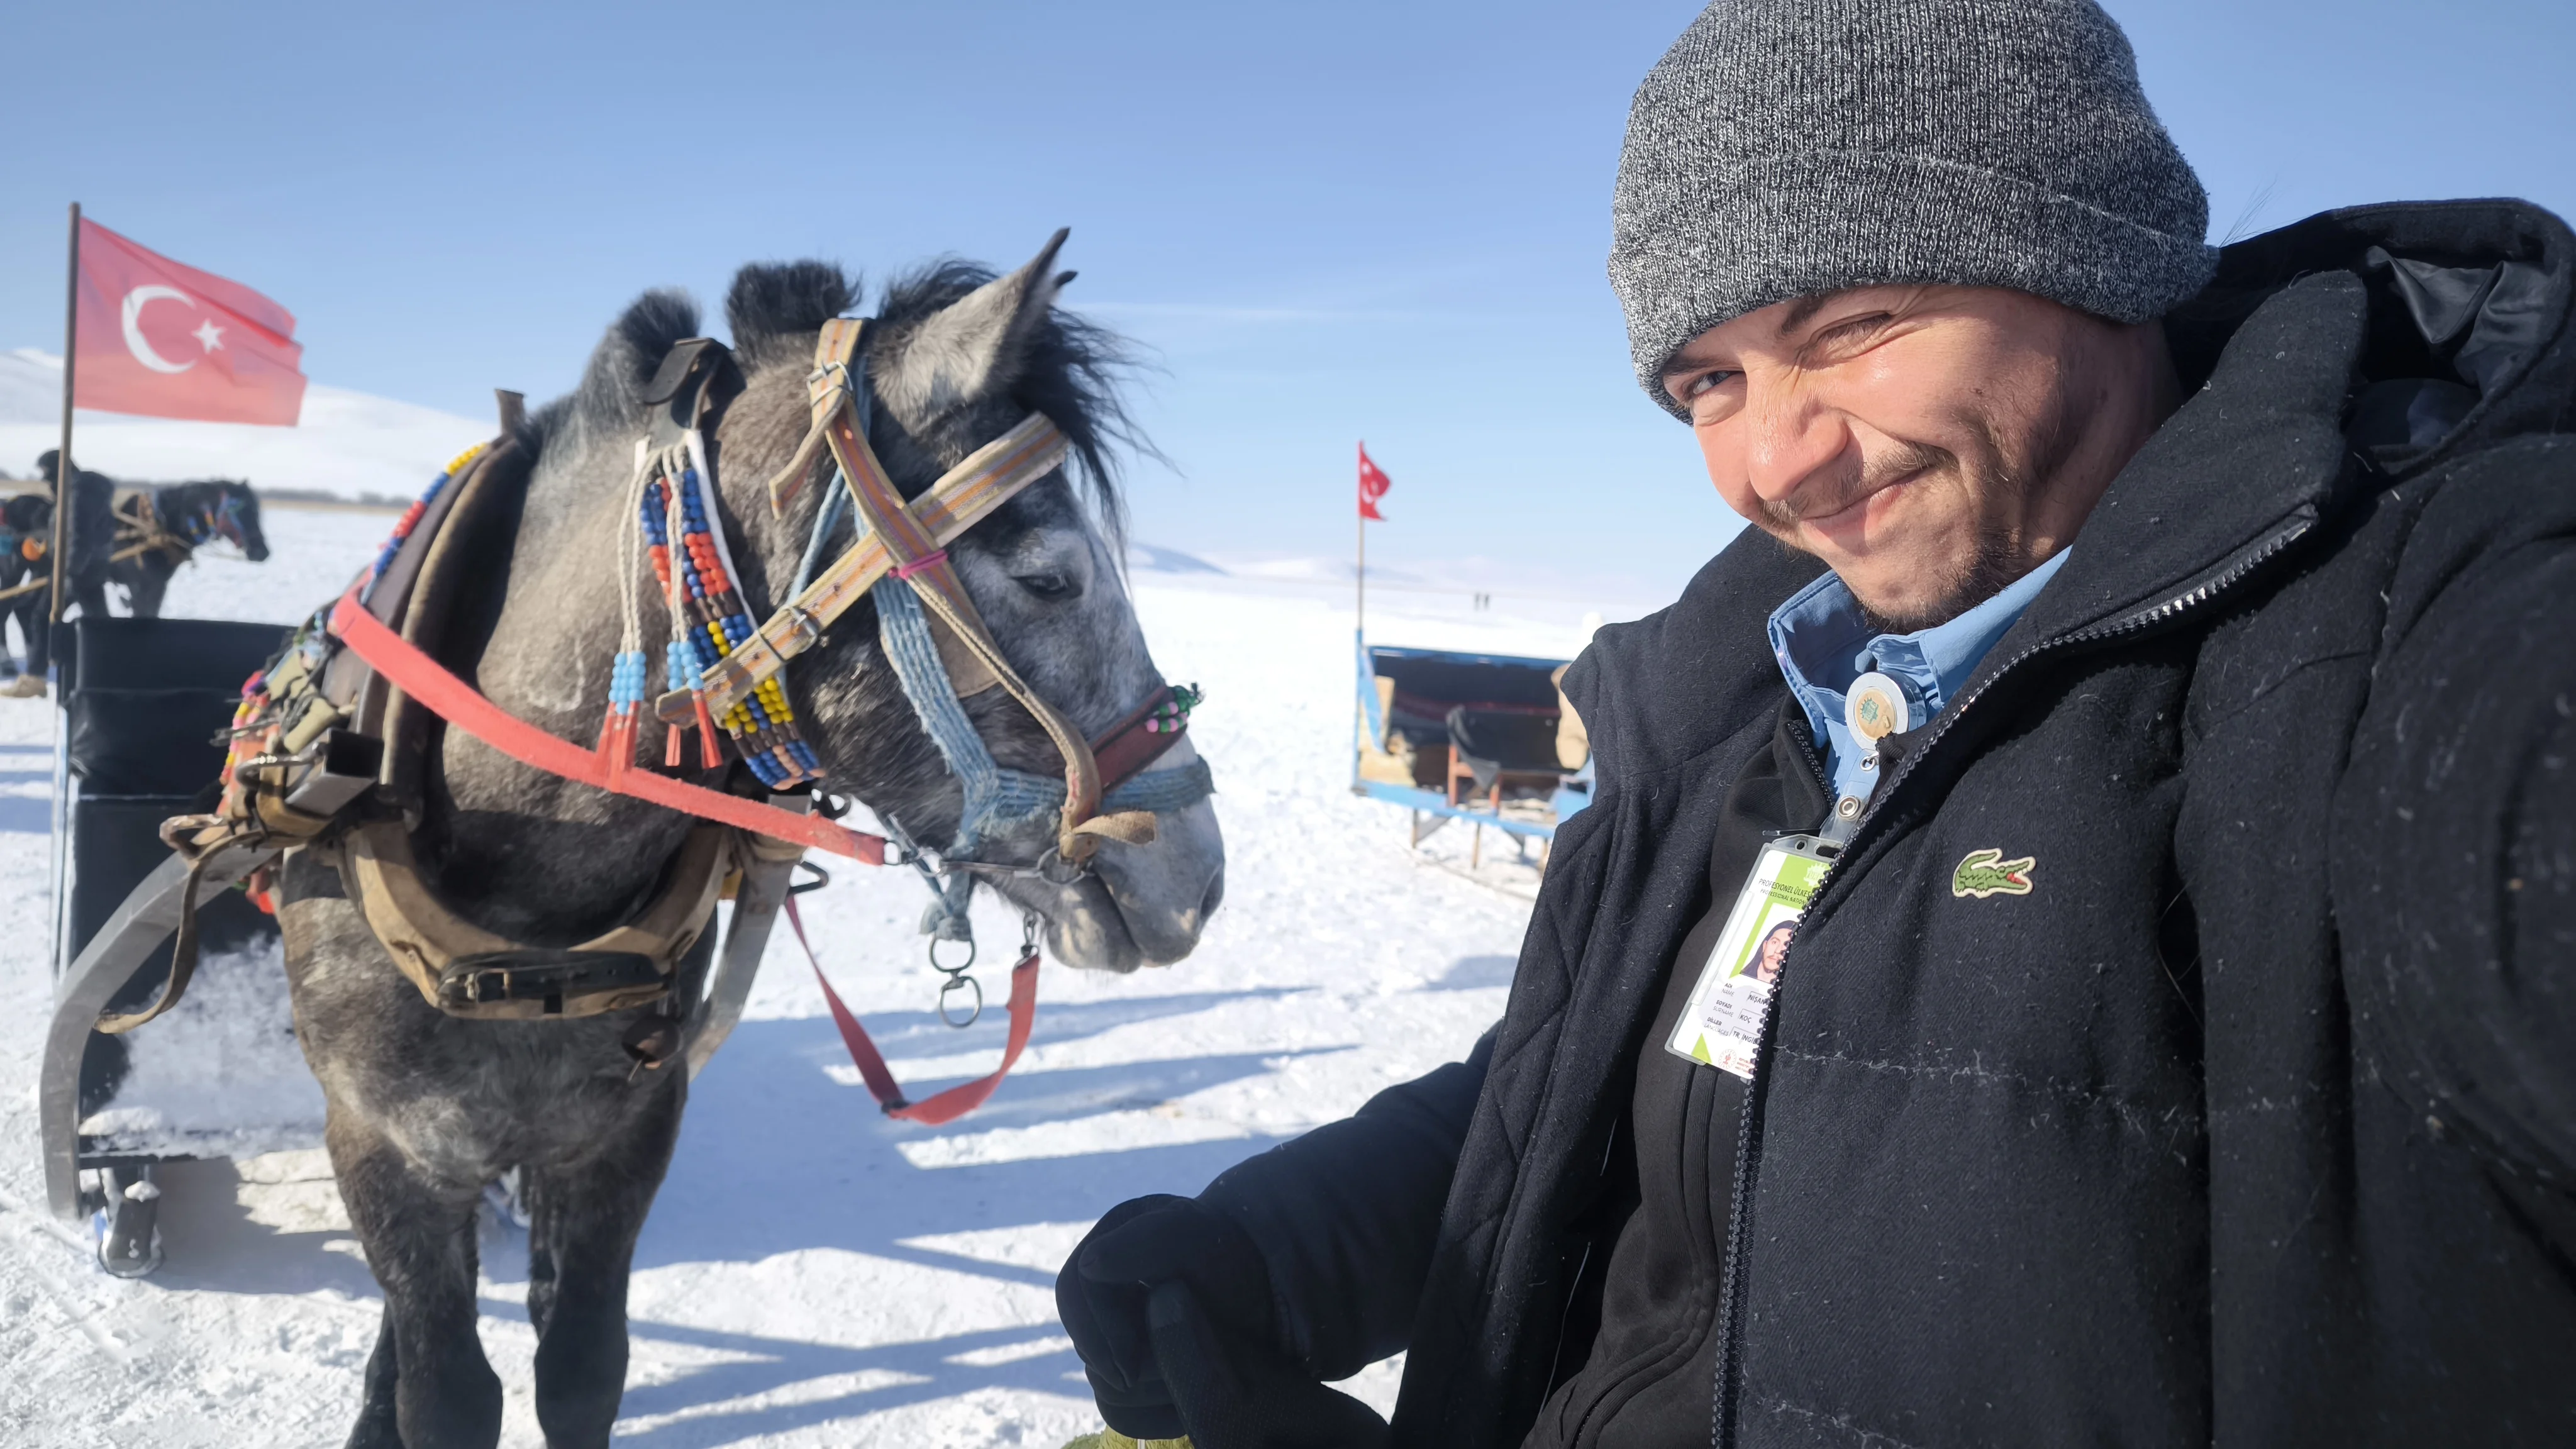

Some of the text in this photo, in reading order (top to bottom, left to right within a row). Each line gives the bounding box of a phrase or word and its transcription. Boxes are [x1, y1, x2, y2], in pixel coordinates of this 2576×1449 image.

[1758, 879, 1812, 897] PROFESYONEL ÜLKES
[1790, 897, 1806, 905] NATION
[1716, 999, 1733, 1009] SOYADI
[1713, 1006, 1734, 1017] SURNAME
[1707, 1016, 1722, 1026] DİLLER
[1739, 1014, 1752, 1024] KOÇ
[1704, 1023, 1729, 1036] LANGUAGES
[1741, 1033, 1758, 1045] İNGİL
